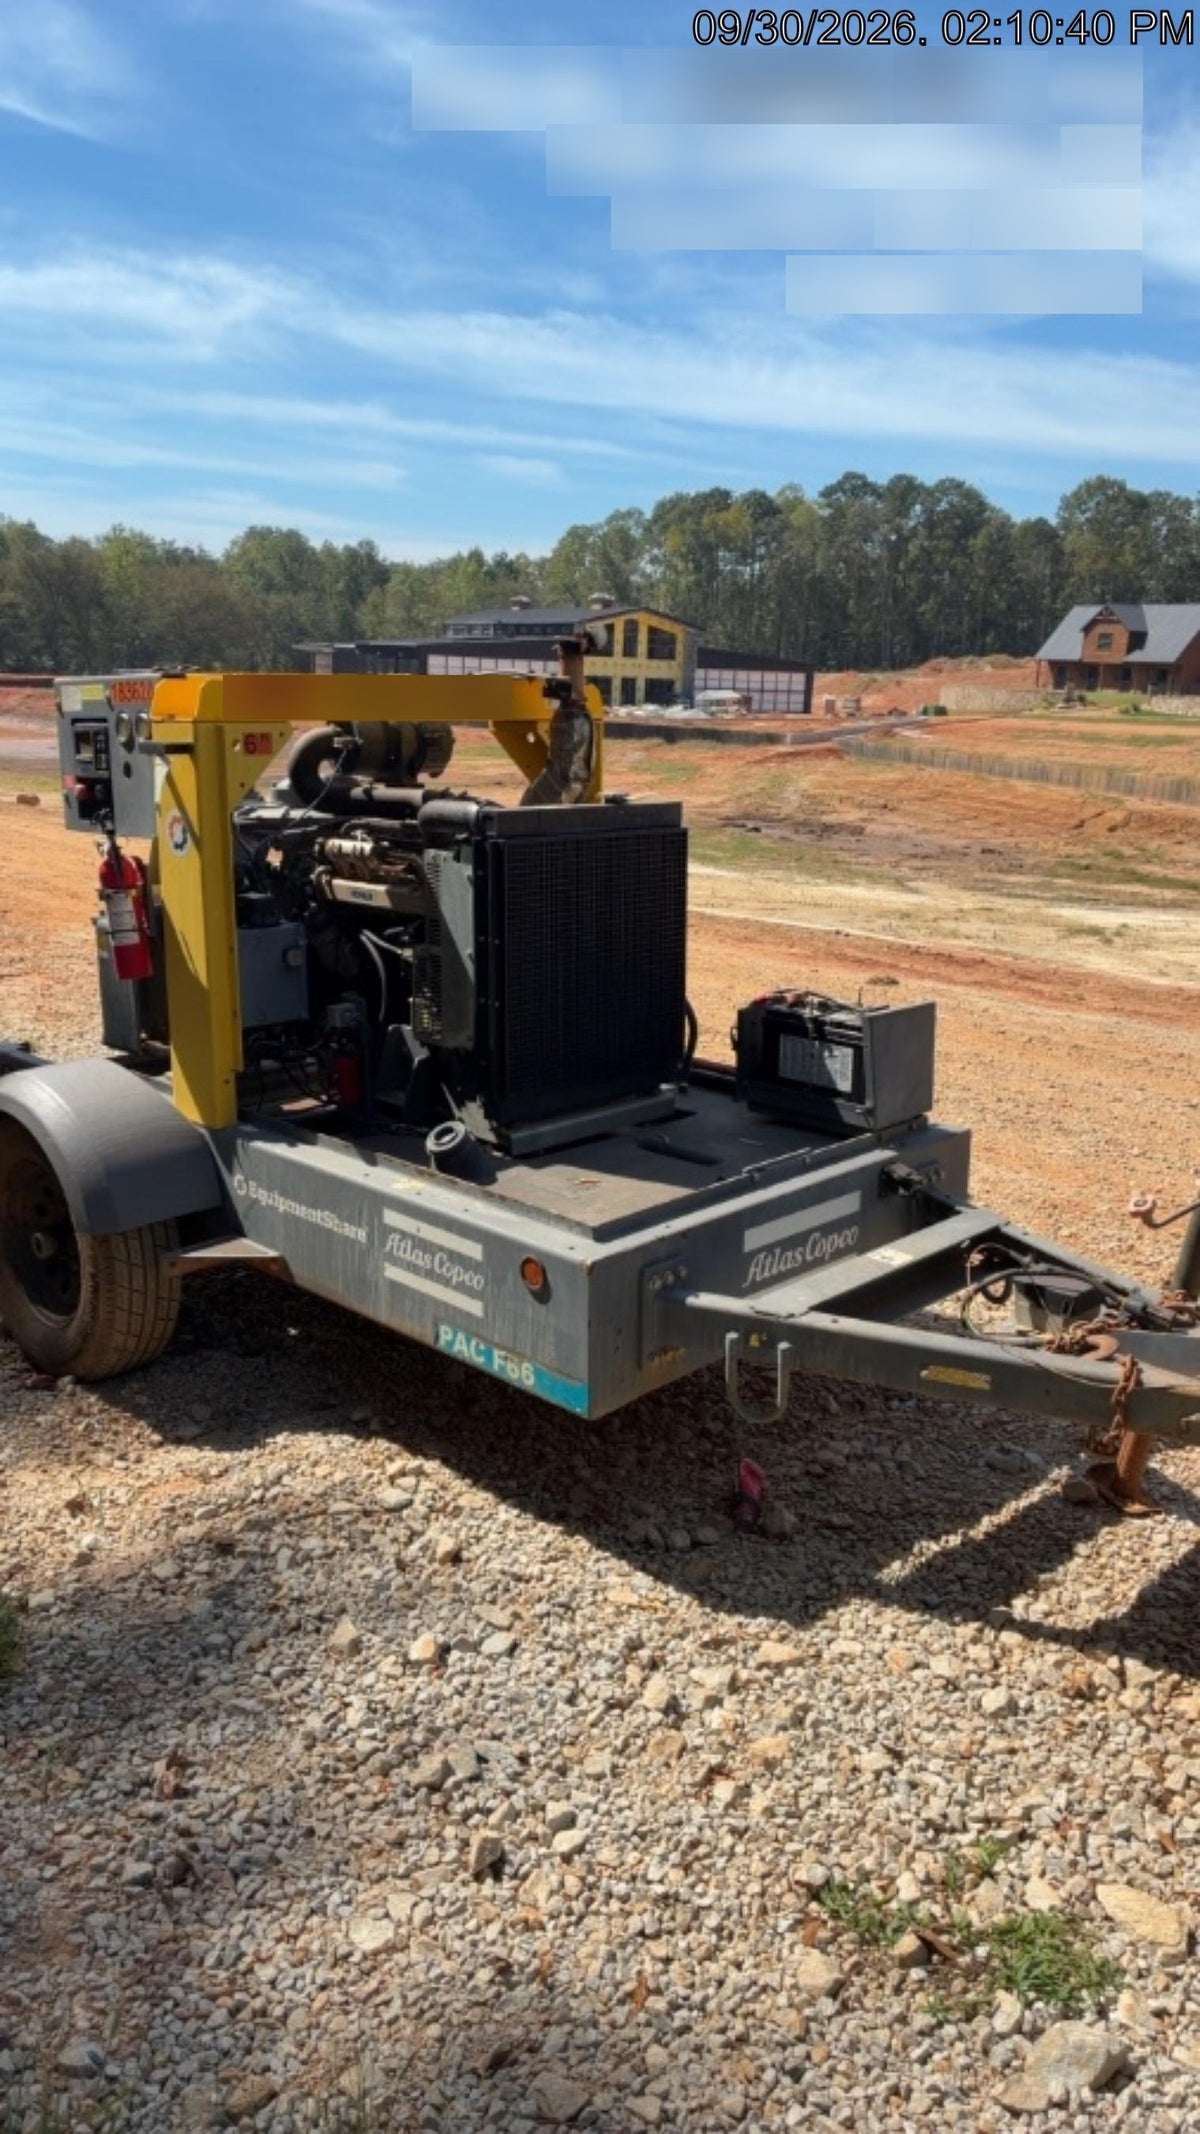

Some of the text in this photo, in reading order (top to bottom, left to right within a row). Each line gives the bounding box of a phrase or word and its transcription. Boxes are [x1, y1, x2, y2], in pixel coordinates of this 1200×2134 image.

[384, 1232, 485, 1291] Atlas Copco
[742, 1224, 860, 1288] Atlas Copco
[438, 1323, 485, 1363] PAC
